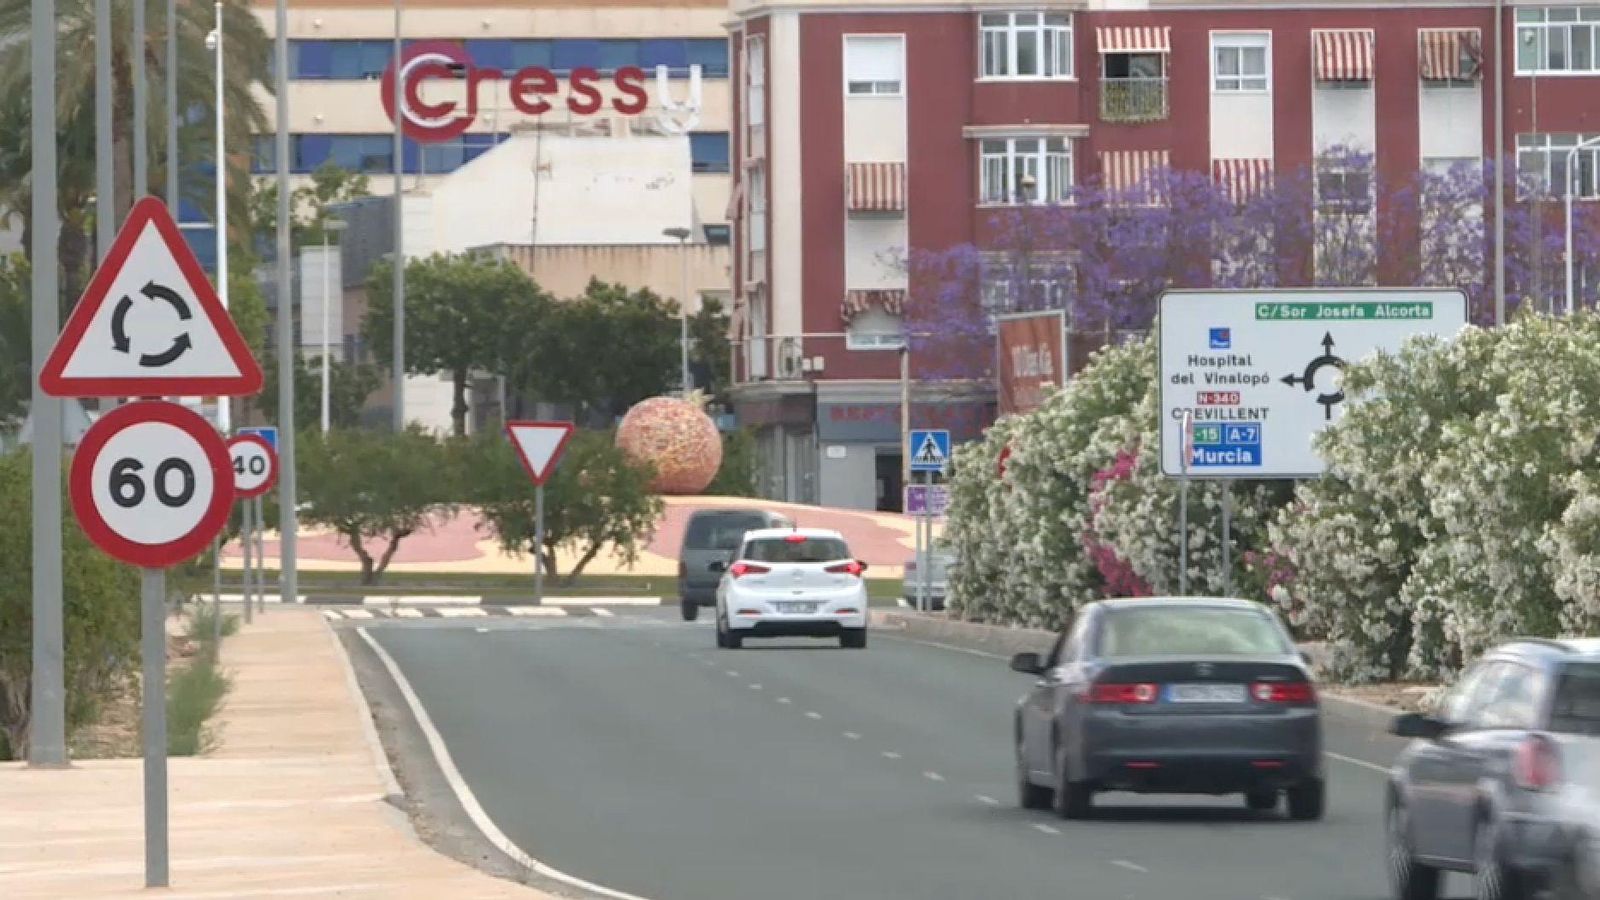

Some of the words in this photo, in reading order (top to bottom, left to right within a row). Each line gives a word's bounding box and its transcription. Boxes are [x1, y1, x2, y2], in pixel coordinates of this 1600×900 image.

[1316, 304, 1365, 318] Josefa
[1374, 304, 1430, 318] Alcorta
[1187, 354, 1252, 368] Hospital
[1170, 372, 1194, 384] del
[1204, 372, 1270, 387] Vinalopó
[1199, 392, 1239, 404] N-340
[1229, 427, 1257, 441] A-7
[1191, 447, 1253, 464] Murcia
[233, 455, 266, 475] 40
[108, 457, 196, 508] 60
